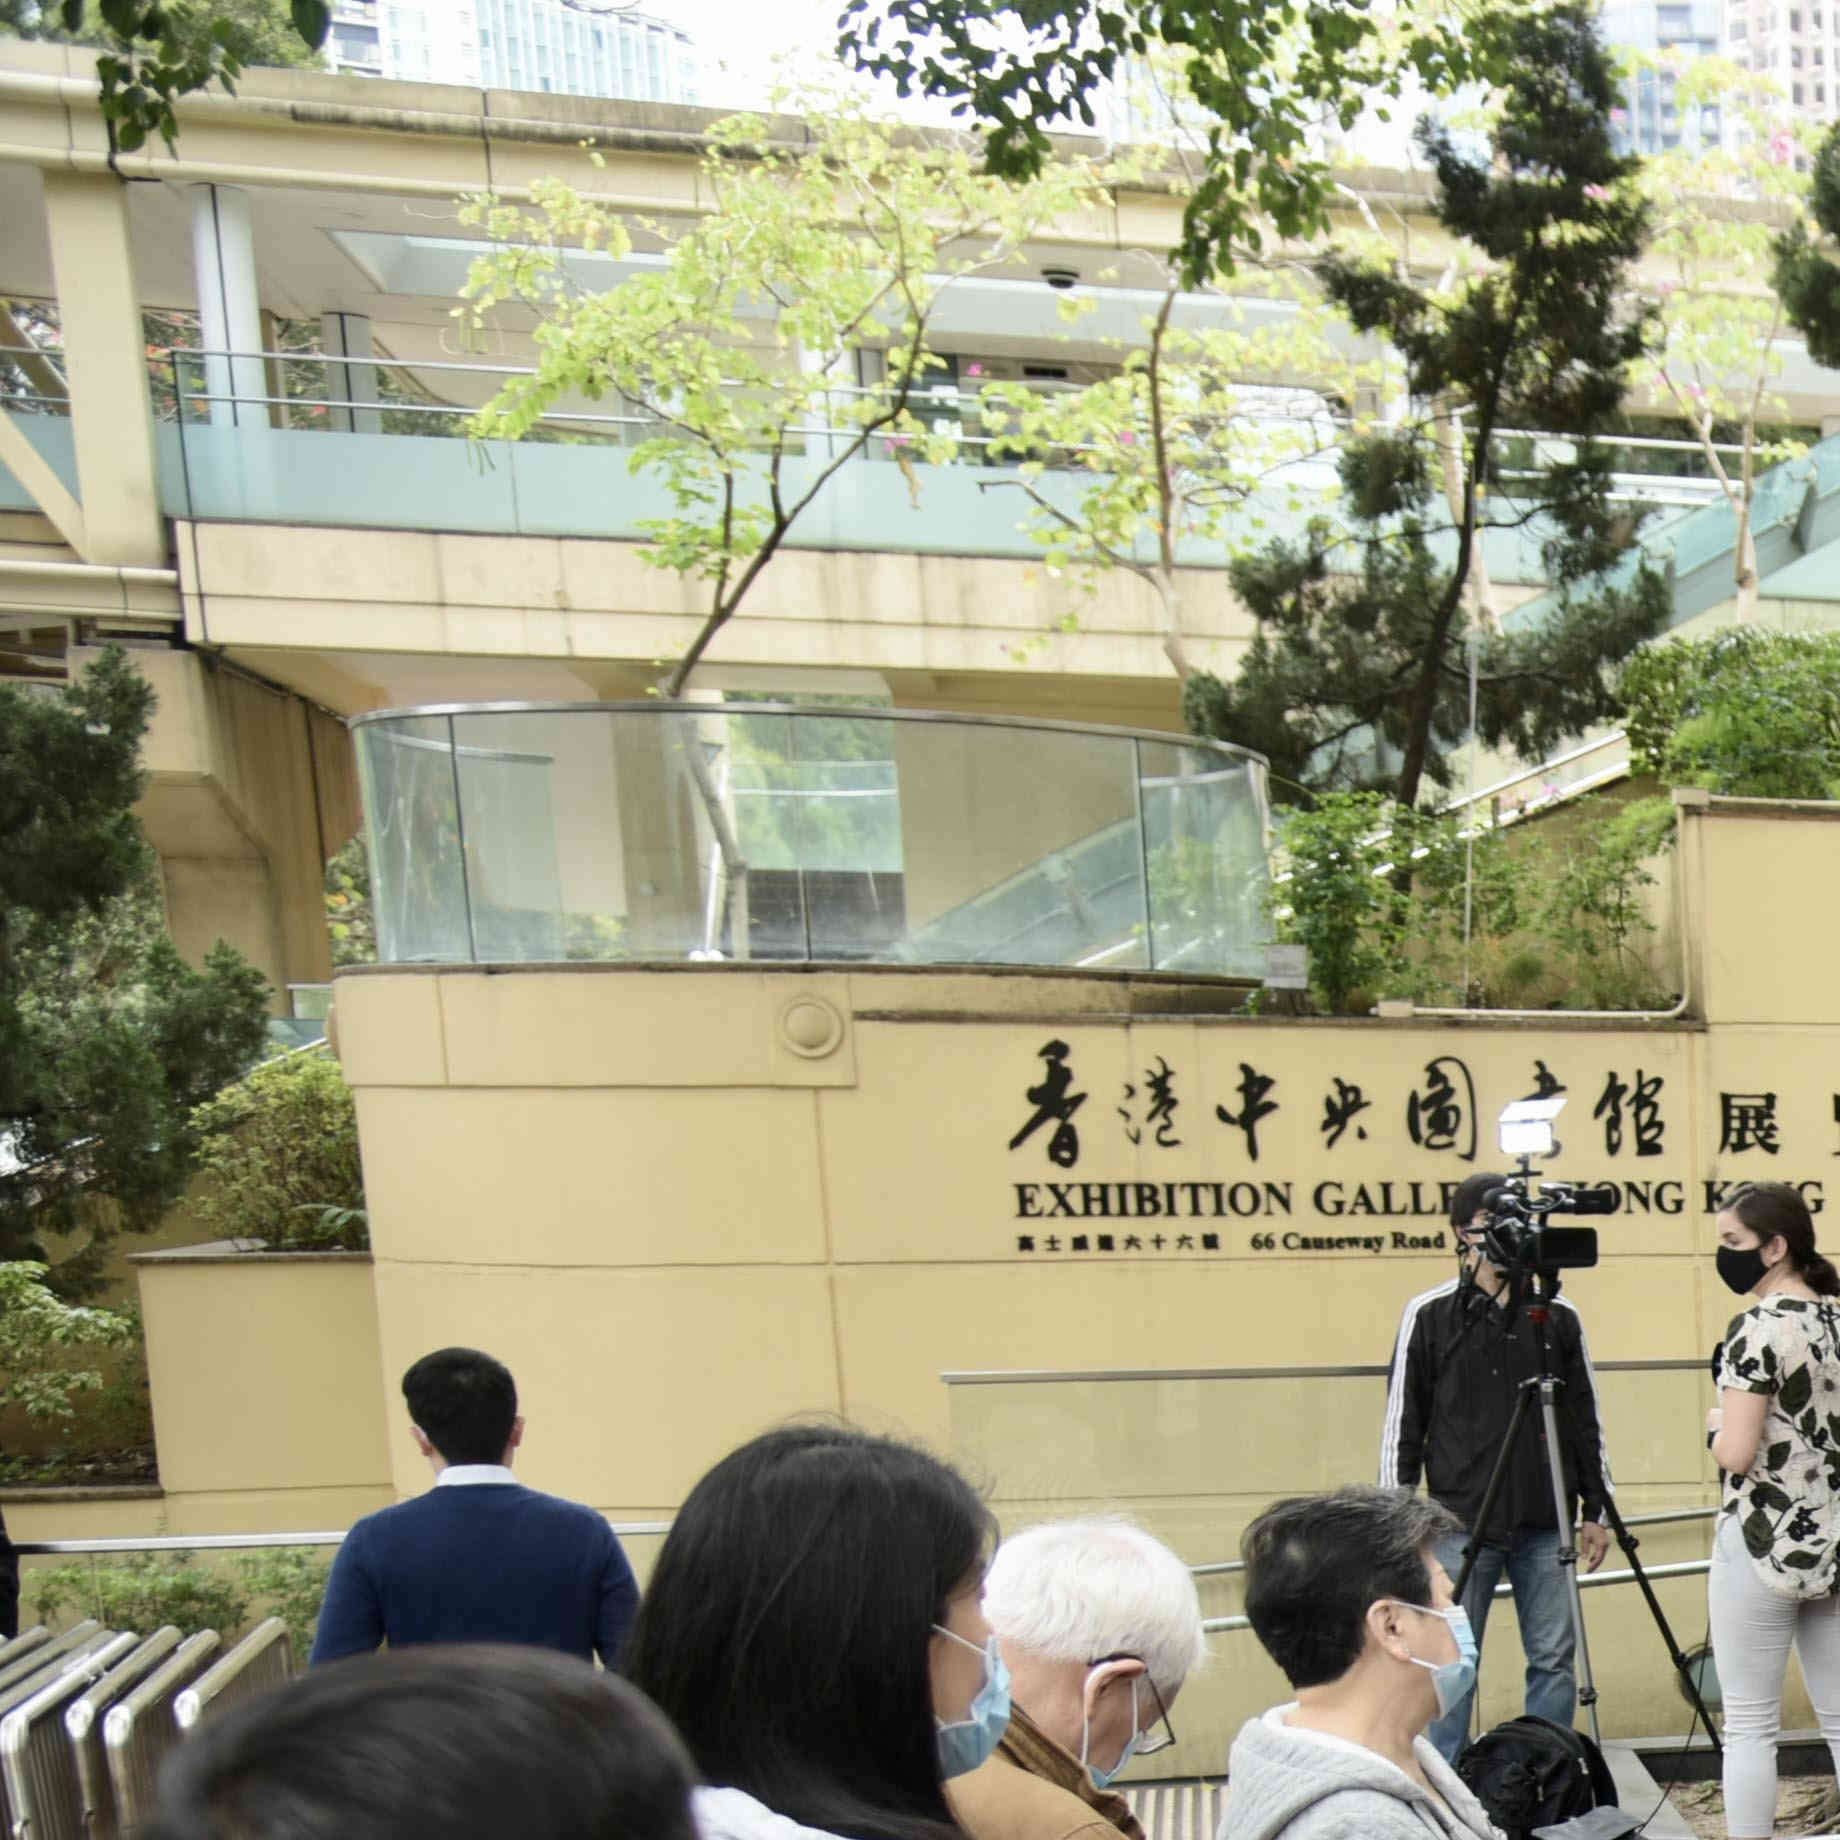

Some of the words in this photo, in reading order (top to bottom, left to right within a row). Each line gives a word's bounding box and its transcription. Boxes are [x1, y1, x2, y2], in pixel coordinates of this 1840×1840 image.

[1014, 1183, 1293, 1217] EXHIBITION
[1313, 1182, 1456, 1216] GALLE
[1250, 1232, 1275, 1250] 66
[1282, 1232, 1387, 1253] Causeway
[1391, 1232, 1446, 1249] Road
